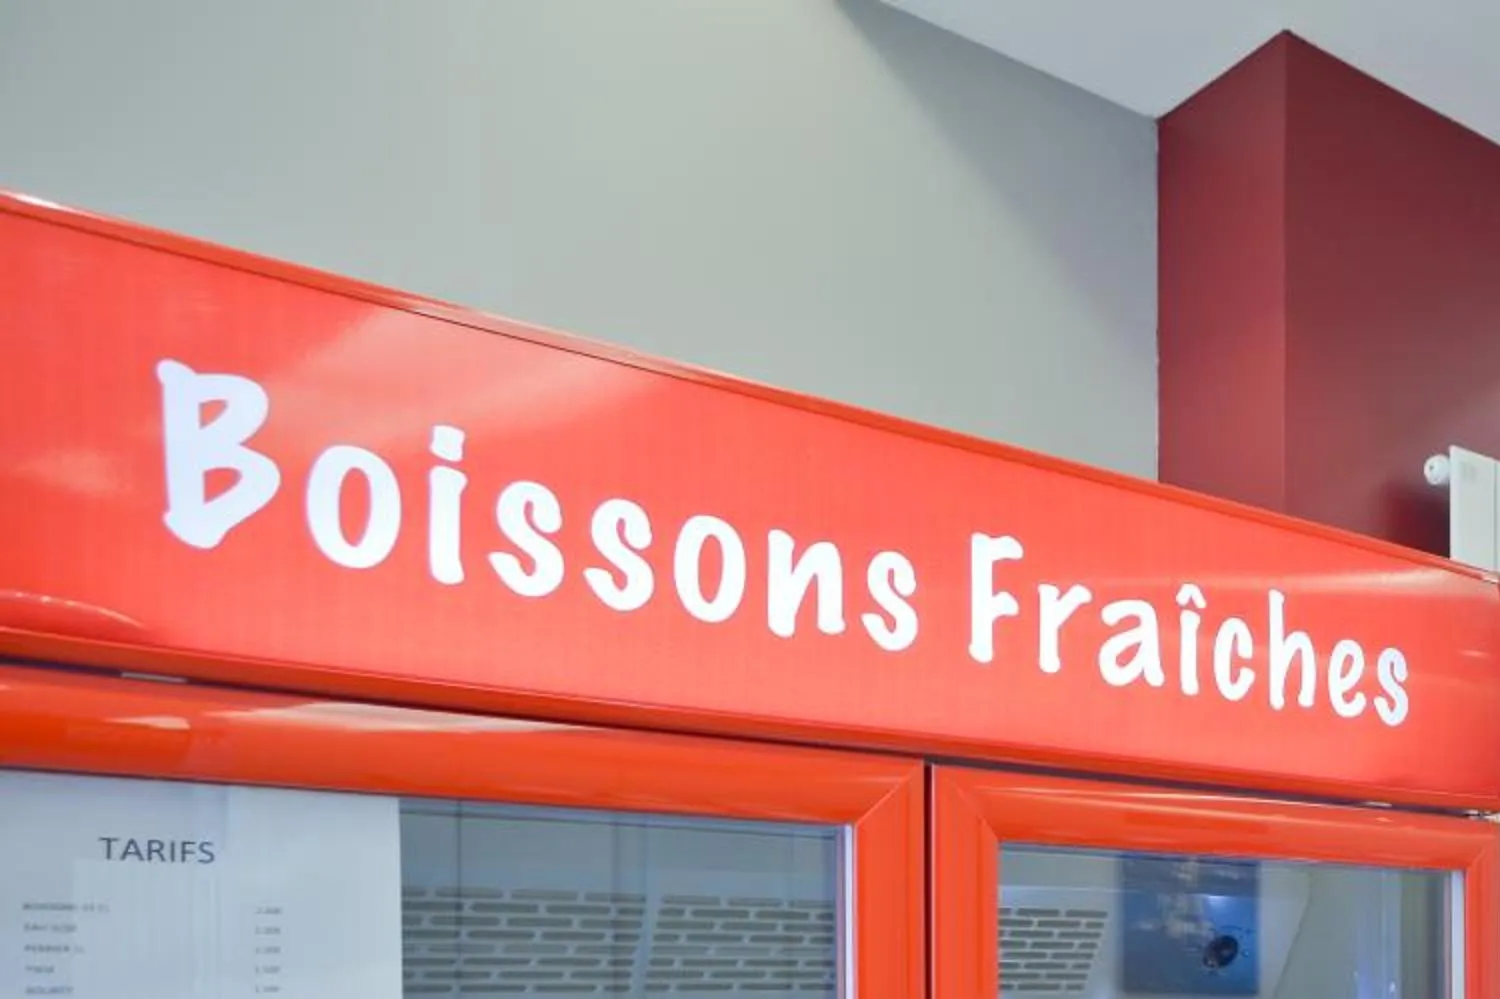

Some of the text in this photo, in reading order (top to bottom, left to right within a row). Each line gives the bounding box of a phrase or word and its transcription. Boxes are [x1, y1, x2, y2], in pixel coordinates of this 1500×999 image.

[155, 358, 1410, 726] Boissons Fraîches
[100, 837, 216, 865] TARIFS
